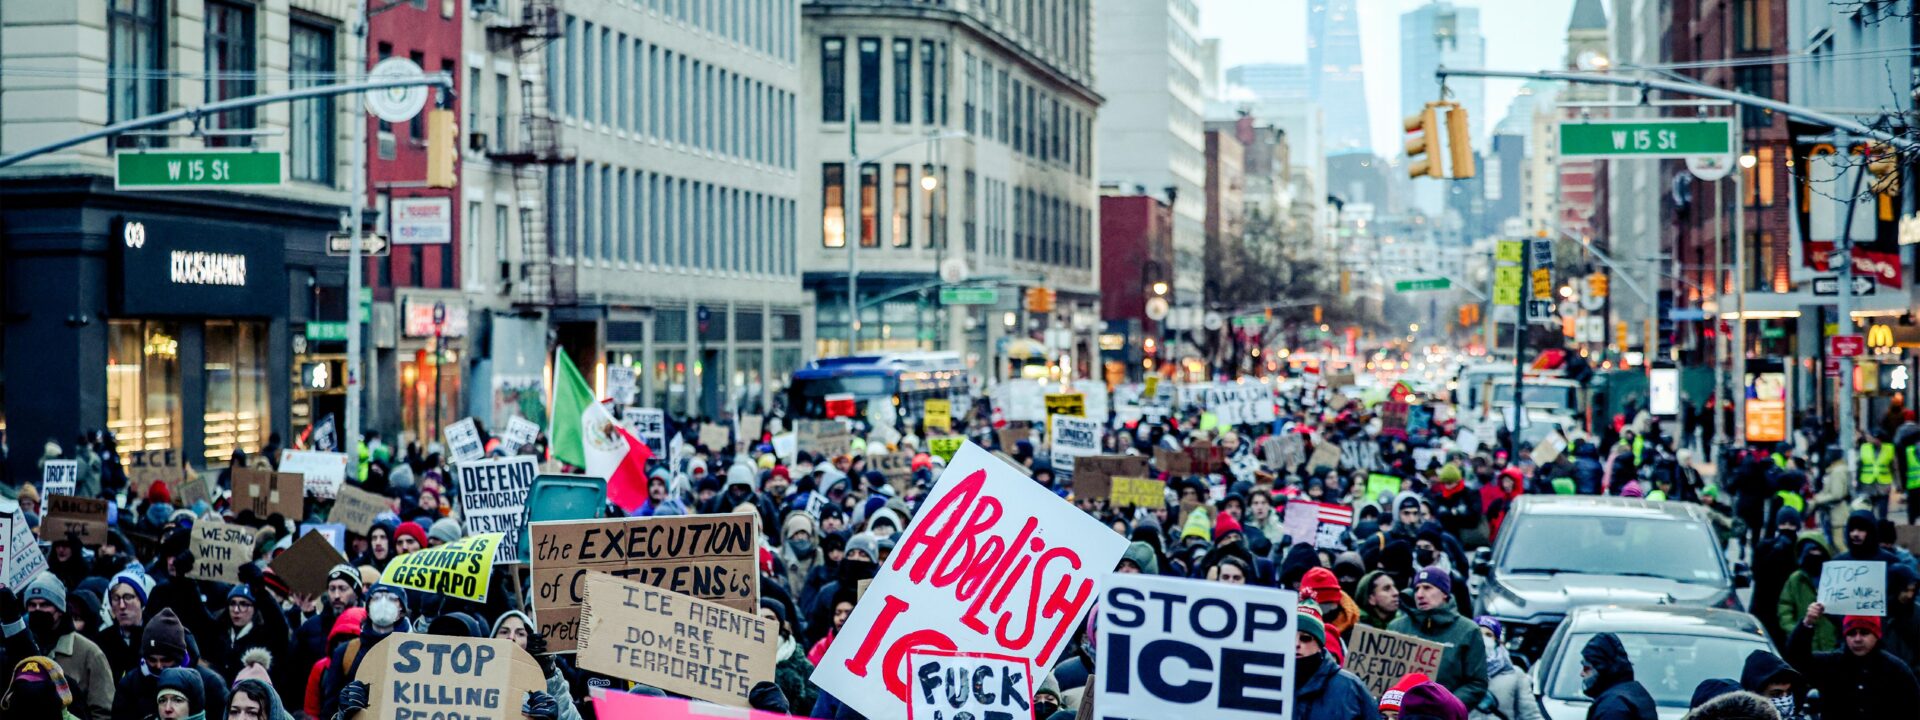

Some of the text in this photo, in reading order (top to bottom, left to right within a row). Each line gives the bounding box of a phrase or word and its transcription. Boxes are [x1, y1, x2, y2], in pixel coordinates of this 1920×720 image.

[1612, 130, 1676, 149] W 15 St
[168, 160, 230, 180] W 15 St
[46, 465, 64, 482] DROP
[130, 450, 176, 468] ICE
[462, 461, 535, 493] DEFEND
[465, 490, 530, 510] DEMOCRAC
[64, 522, 89, 537] ICE
[202, 527, 254, 546] WE STAND
[538, 533, 573, 561] the
[579, 522, 752, 560] EXECUTION
[200, 544, 231, 560] WITH
[200, 563, 223, 577] MN
[392, 565, 477, 597] GESTAPO
[1821, 565, 1869, 587] STOP
[540, 573, 564, 602] of
[730, 569, 751, 597] is
[622, 585, 765, 644] ICE AGENTS
[1106, 587, 1288, 643] STOP
[674, 622, 714, 642] ARE
[393, 640, 495, 676] STOP
[625, 626, 750, 674] DOMESTIC
[1358, 631, 1441, 668] INJUSTICE
[613, 644, 750, 698] TERRORISTS
[918, 661, 1030, 711] FUCK
[1105, 633, 1286, 715] ICE
[393, 680, 500, 709] KILLING
